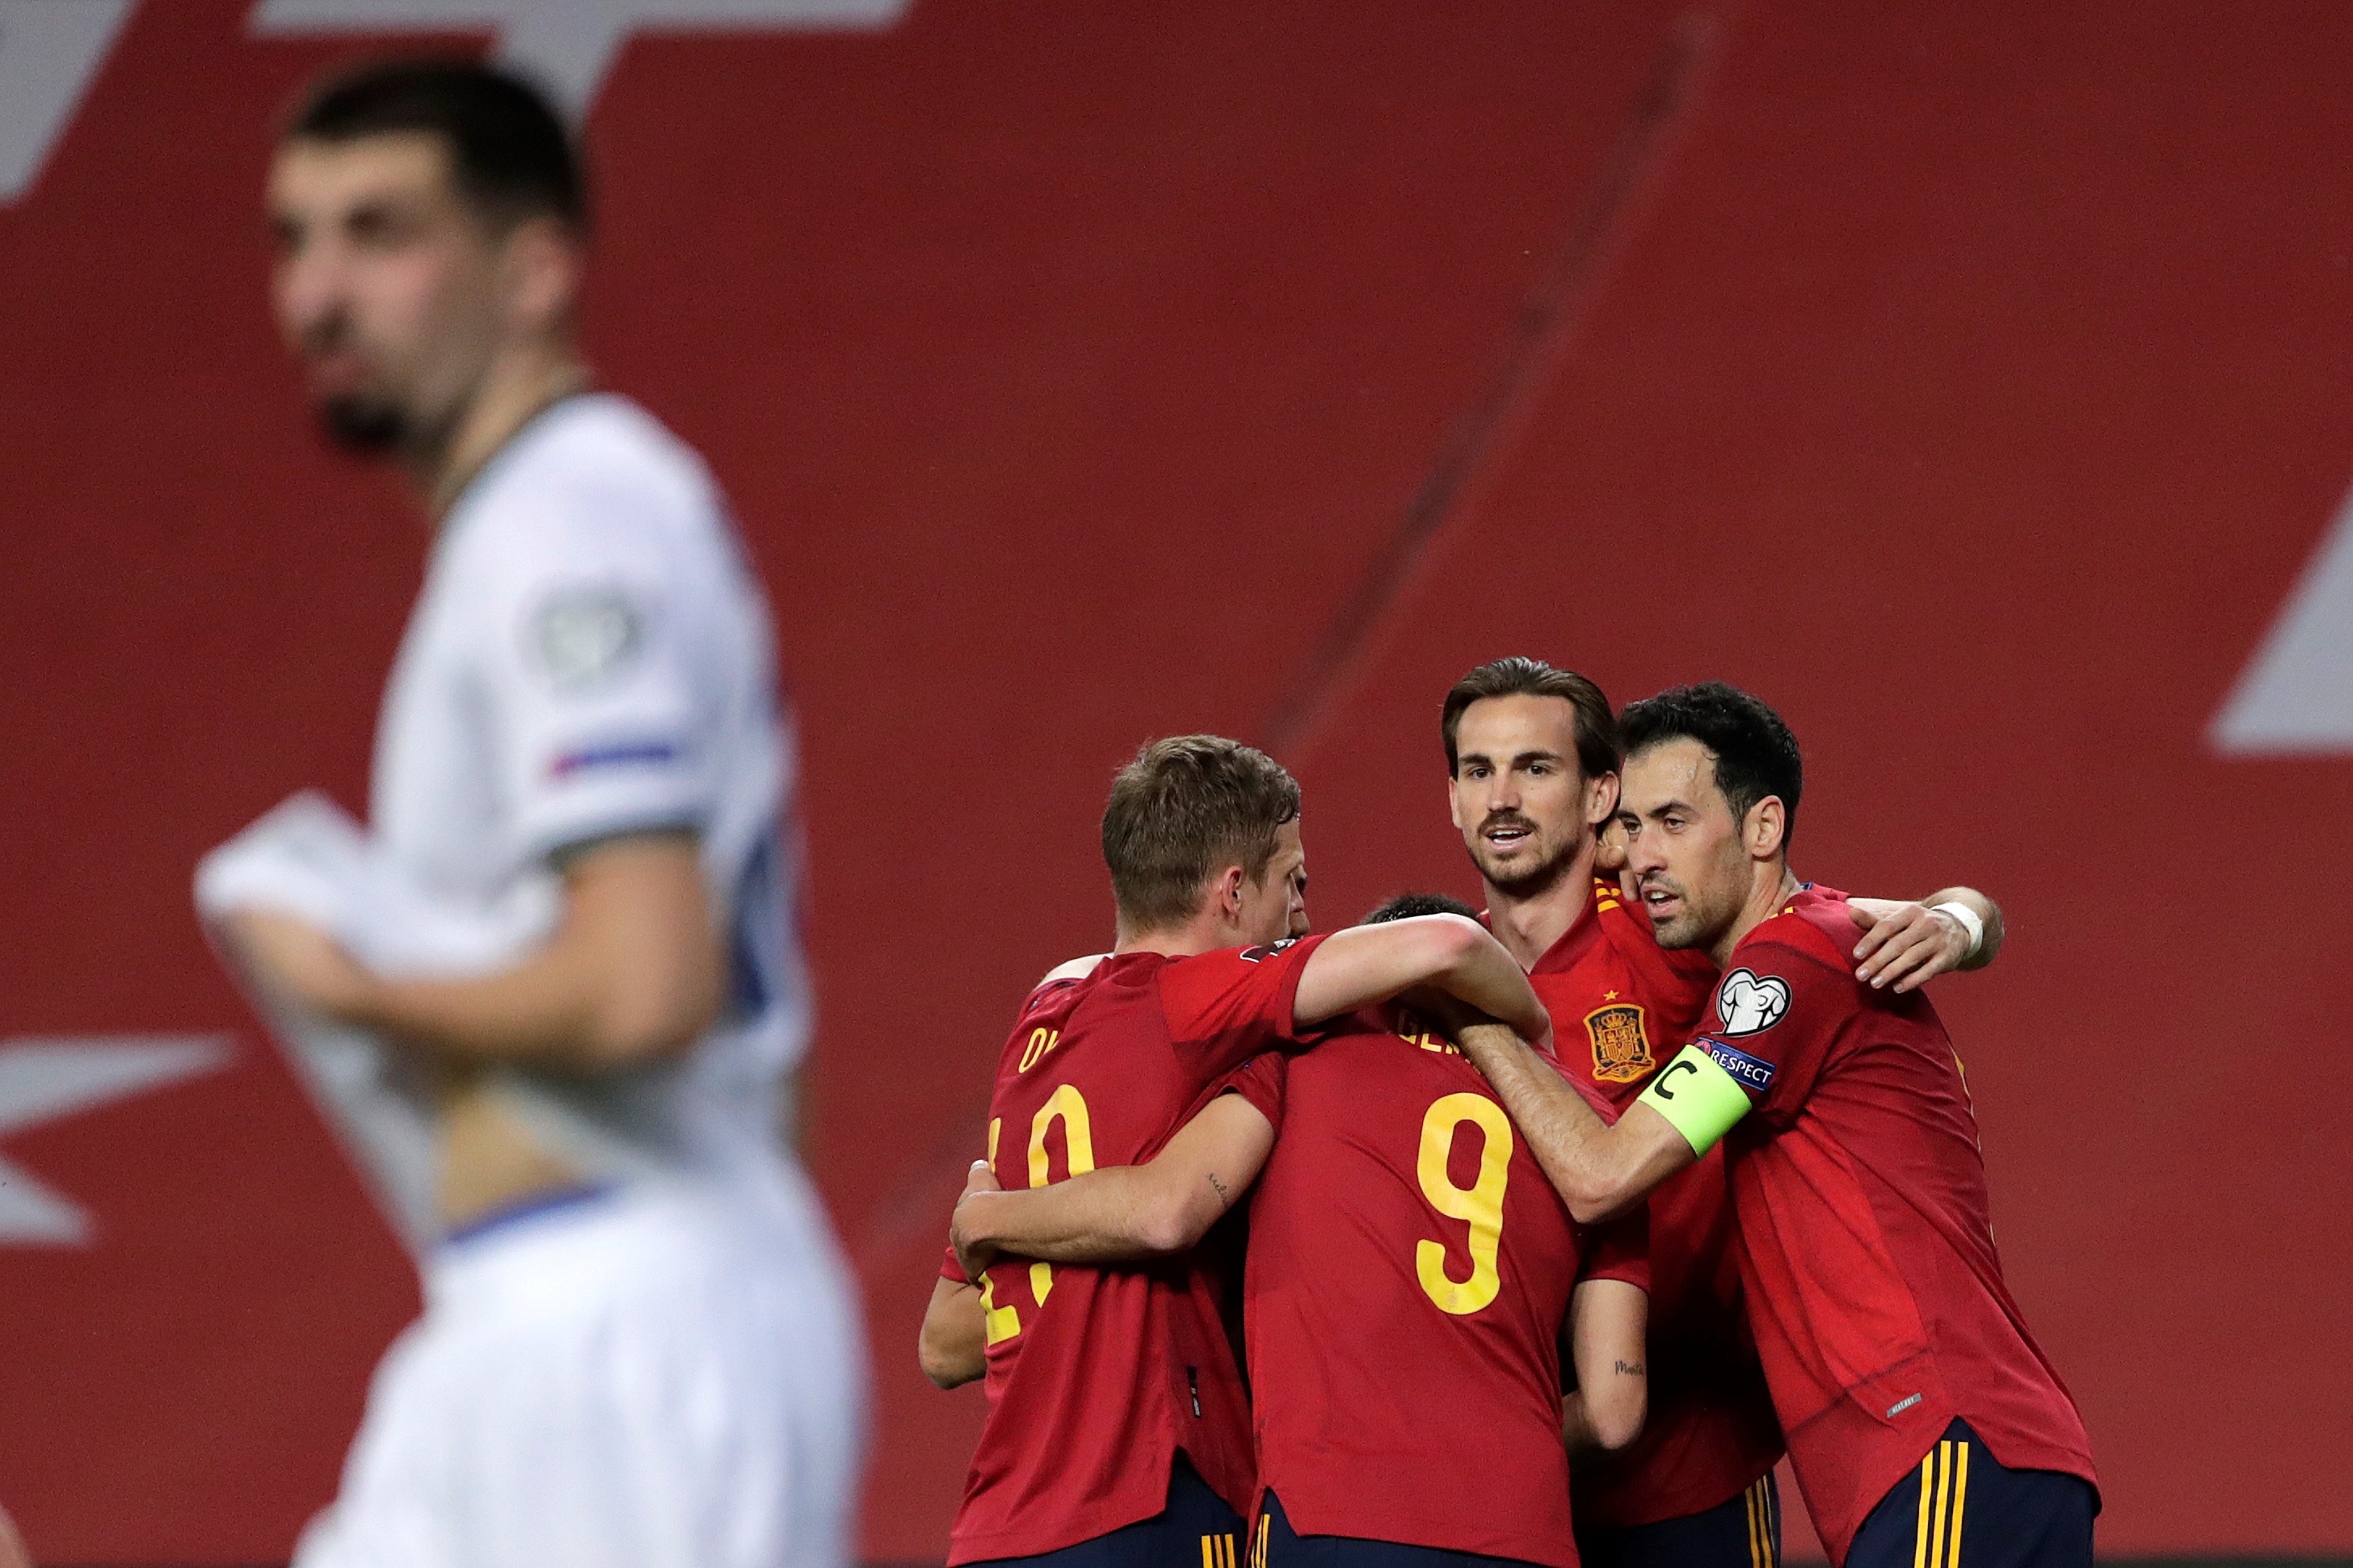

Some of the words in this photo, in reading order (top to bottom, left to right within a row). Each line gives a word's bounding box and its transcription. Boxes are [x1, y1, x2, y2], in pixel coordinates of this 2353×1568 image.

[1654, 1060, 1697, 1099] C
[1711, 1049, 1771, 1082] RESPECT
[1416, 1092, 1513, 1314] 9
